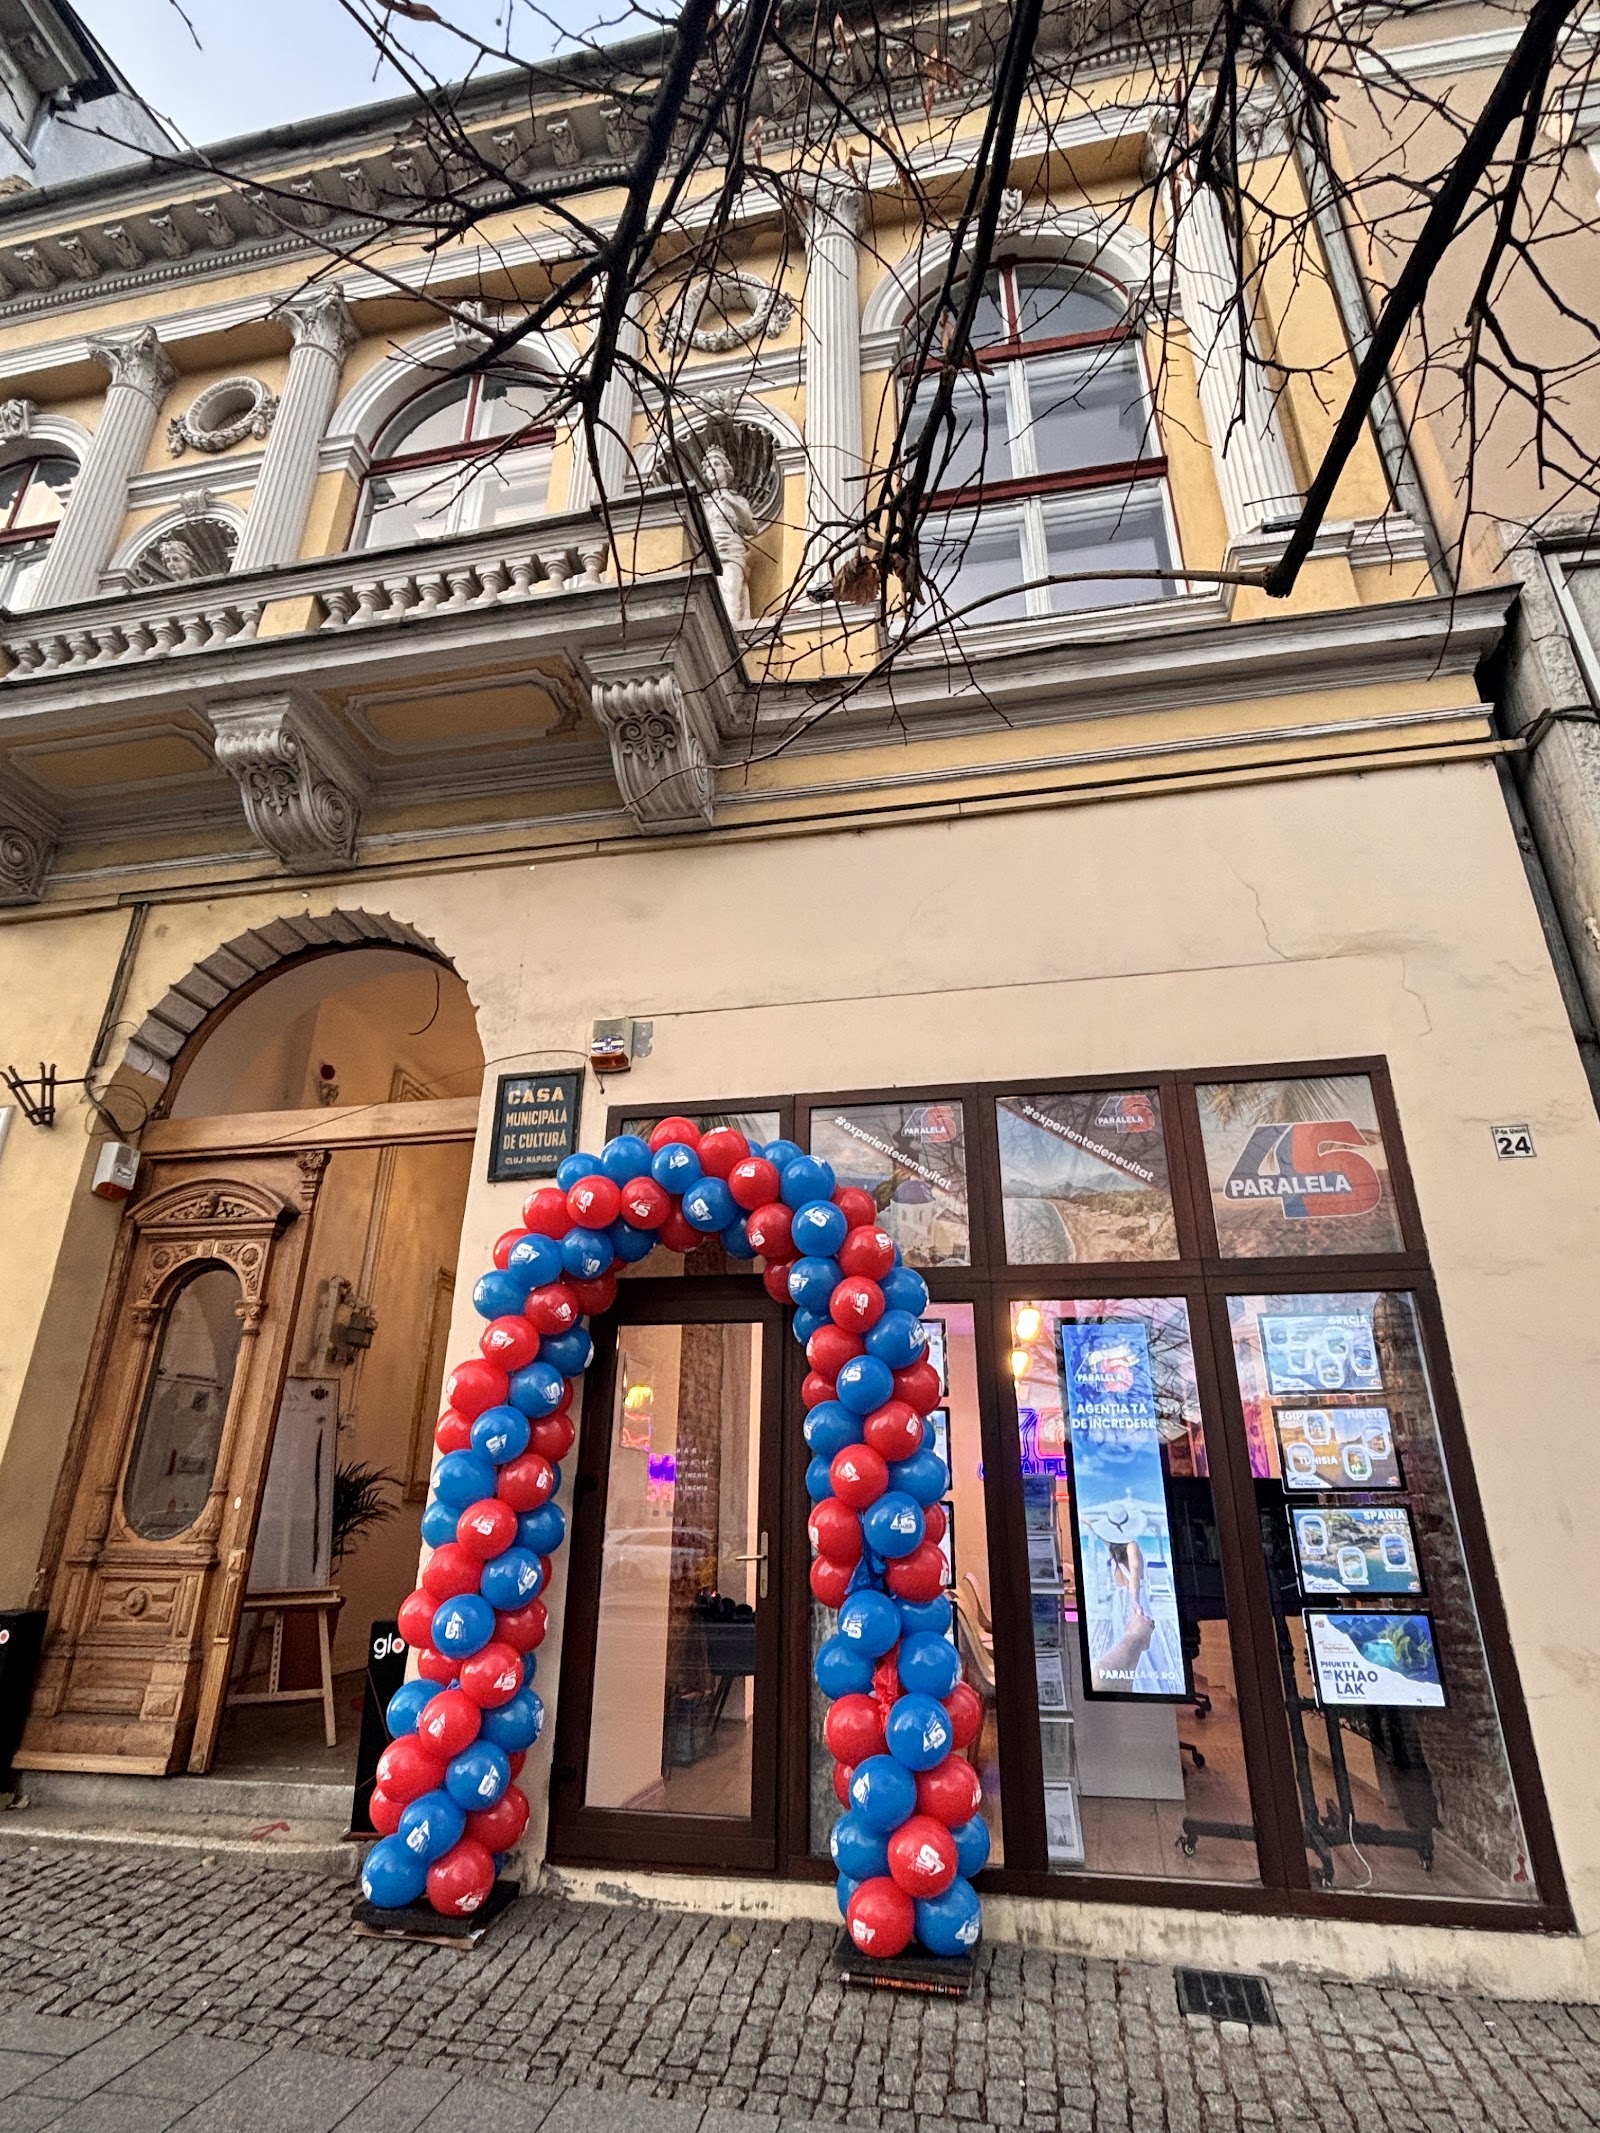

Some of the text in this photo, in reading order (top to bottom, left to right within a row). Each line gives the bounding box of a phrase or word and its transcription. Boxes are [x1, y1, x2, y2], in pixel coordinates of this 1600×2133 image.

[507, 1087, 564, 1105] CASA
[1098, 1115, 1144, 1125] PARALELA
[904, 1126, 946, 1135] PARALELA
[503, 1134, 517, 1150] DE
[1497, 1136, 1531, 1155] 24
[504, 1154, 558, 1165] CLUJ-NAPOCA
[1223, 1120, 1382, 1220] 45
[1230, 1174, 1353, 1197] PARALELA
[1077, 1373, 1123, 1382] PARALELA
[1130, 1403, 1148, 1414] TA
[1345, 1409, 1386, 1421] TURCIA
[1071, 1418, 1088, 1429] DE
[1299, 1455, 1338, 1465] TUNISIA
[1362, 1510, 1407, 1521] SPANIA
[373, 1632, 405, 1660] glo
[1334, 1670, 1379, 1682] KHAO
[1335, 1683, 1365, 1695] LAK
